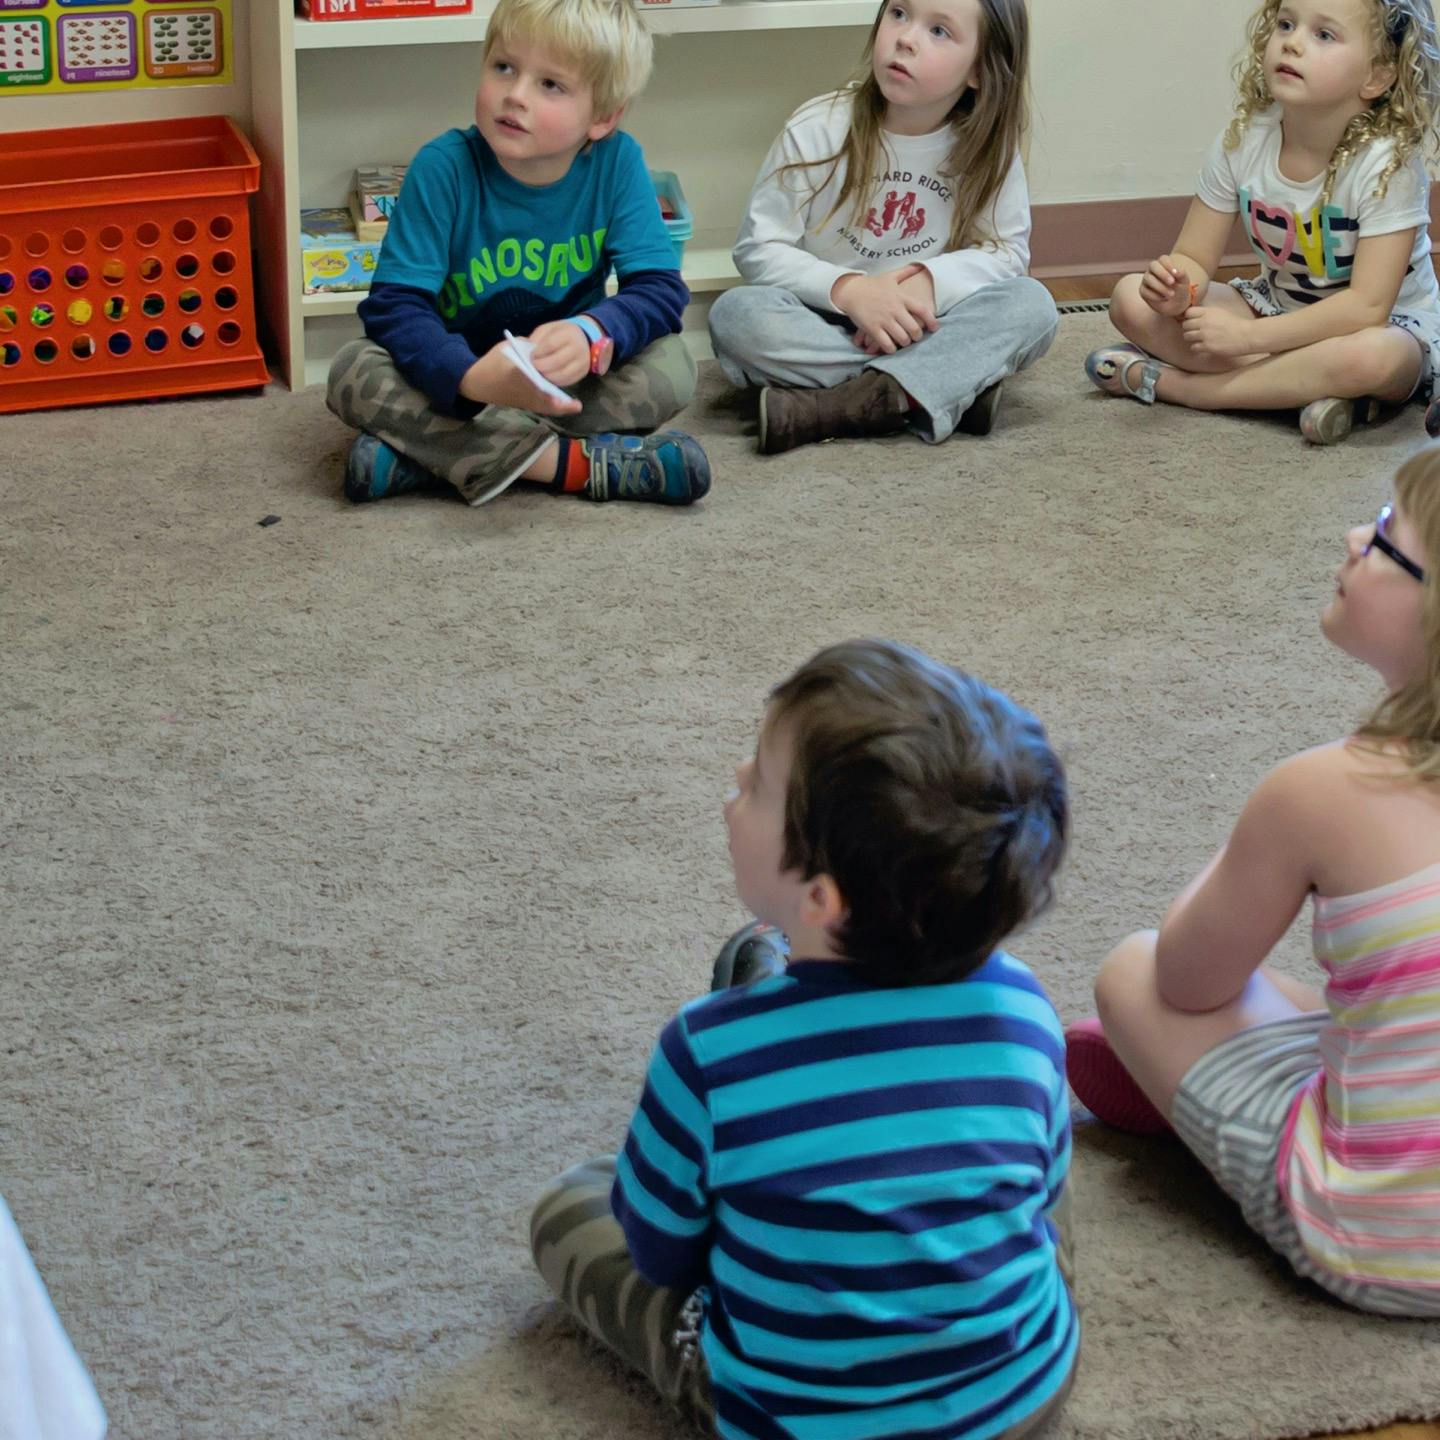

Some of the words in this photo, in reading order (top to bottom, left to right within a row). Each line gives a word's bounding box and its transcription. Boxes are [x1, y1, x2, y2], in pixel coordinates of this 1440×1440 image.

[7, 72, 45, 83] eighteen
[94, 67, 131, 78] nineteen
[917, 174, 953, 203] RIDGE
[835, 226, 883, 259] NURSERY
[886, 235, 939, 259] SCHOOL
